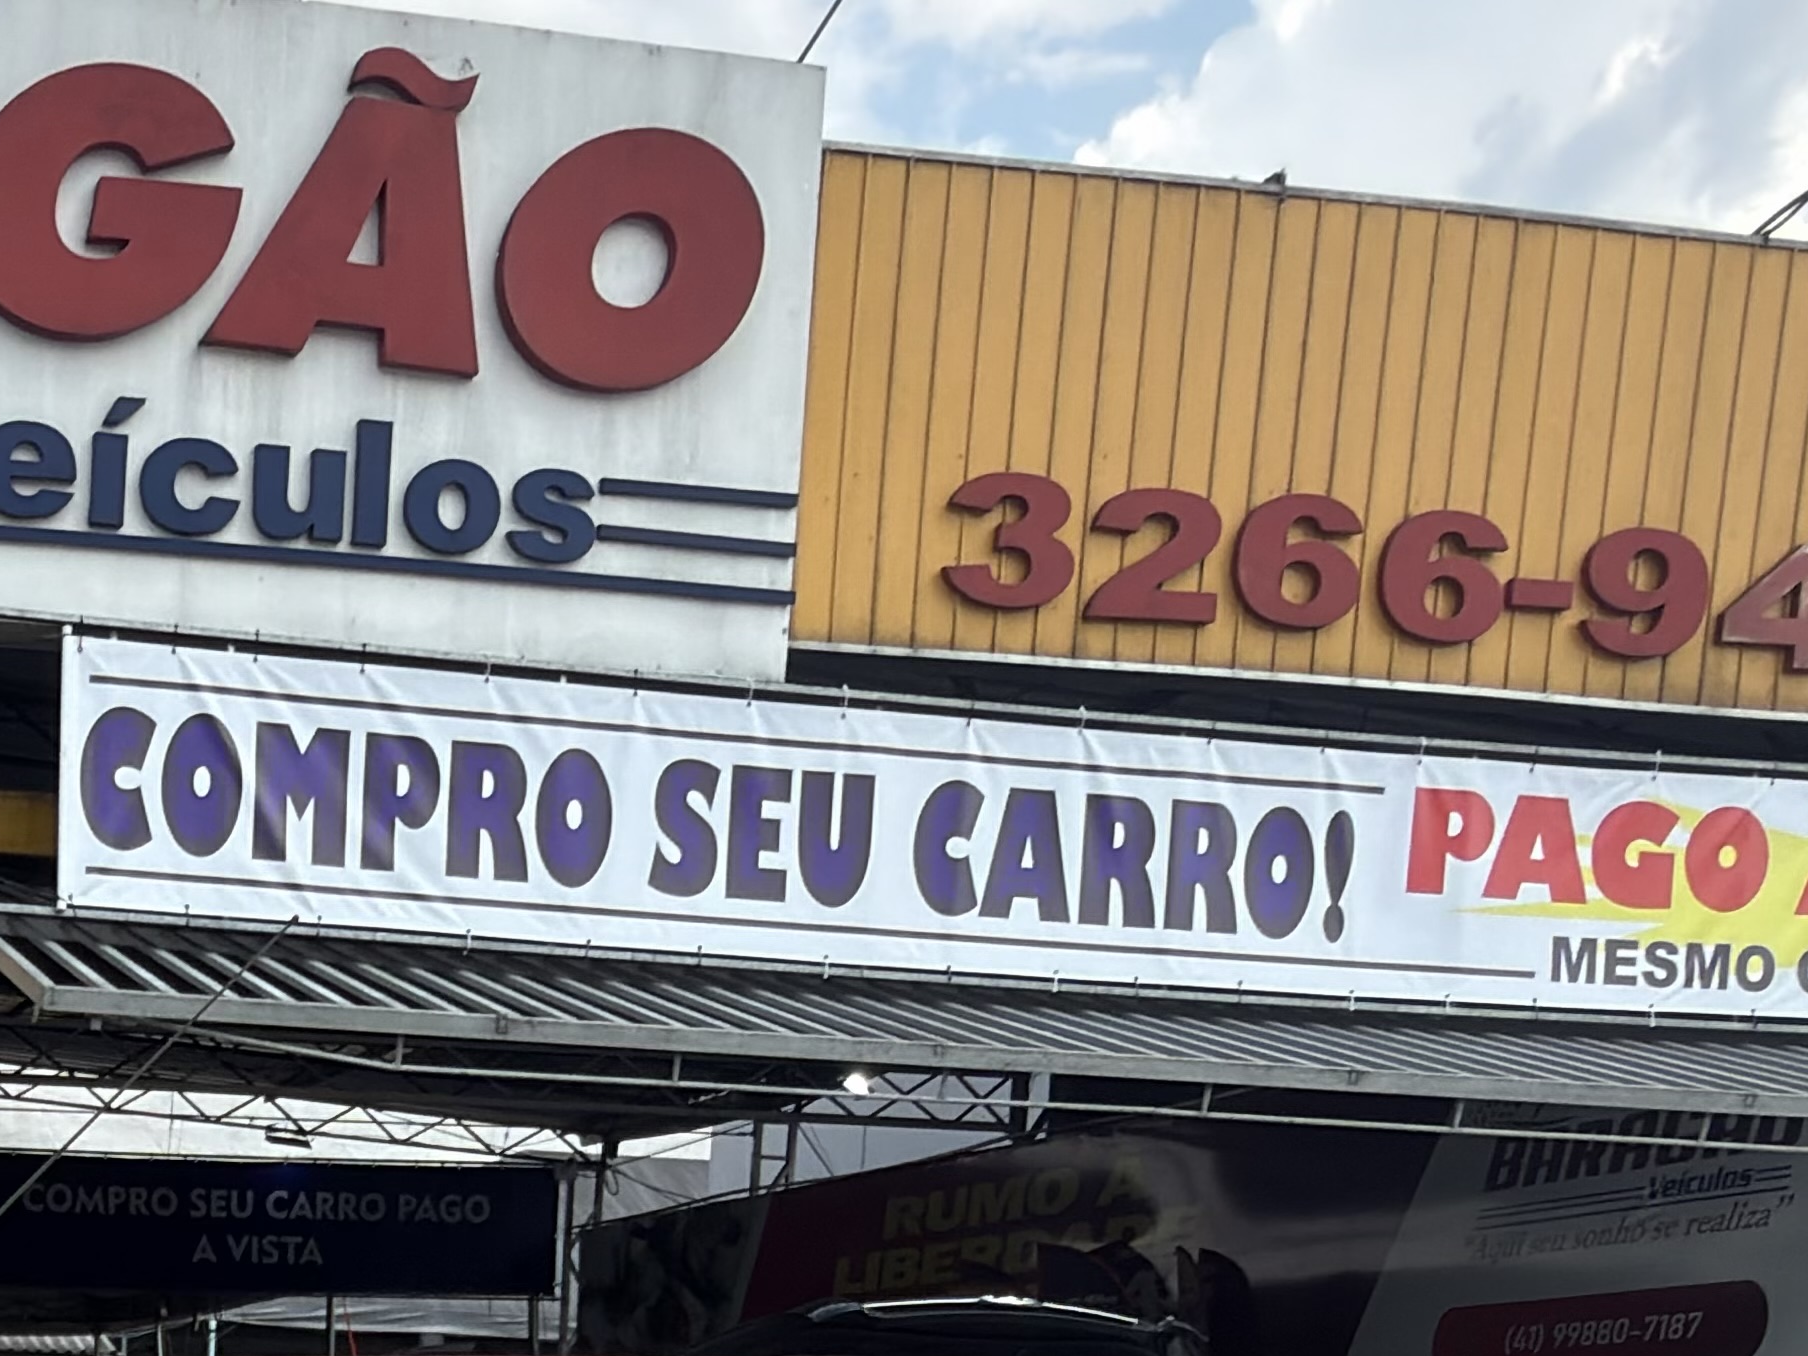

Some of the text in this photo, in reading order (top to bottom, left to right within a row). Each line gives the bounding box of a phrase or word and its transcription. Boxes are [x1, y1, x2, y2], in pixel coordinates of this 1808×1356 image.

[81, 707, 1356, 945] COMPRO SEU CARRO!
[1404, 787, 1771, 915] PAGO
[1549, 935, 1778, 998] MESMO
[23, 1182, 491, 1224] COMPRO SEU CARRO PAGO
[883, 1167, 1081, 1241] RUMO
[193, 1236, 323, 1266] A VISTA
[1504, 1311, 1703, 1356] (41) 99880-7187
